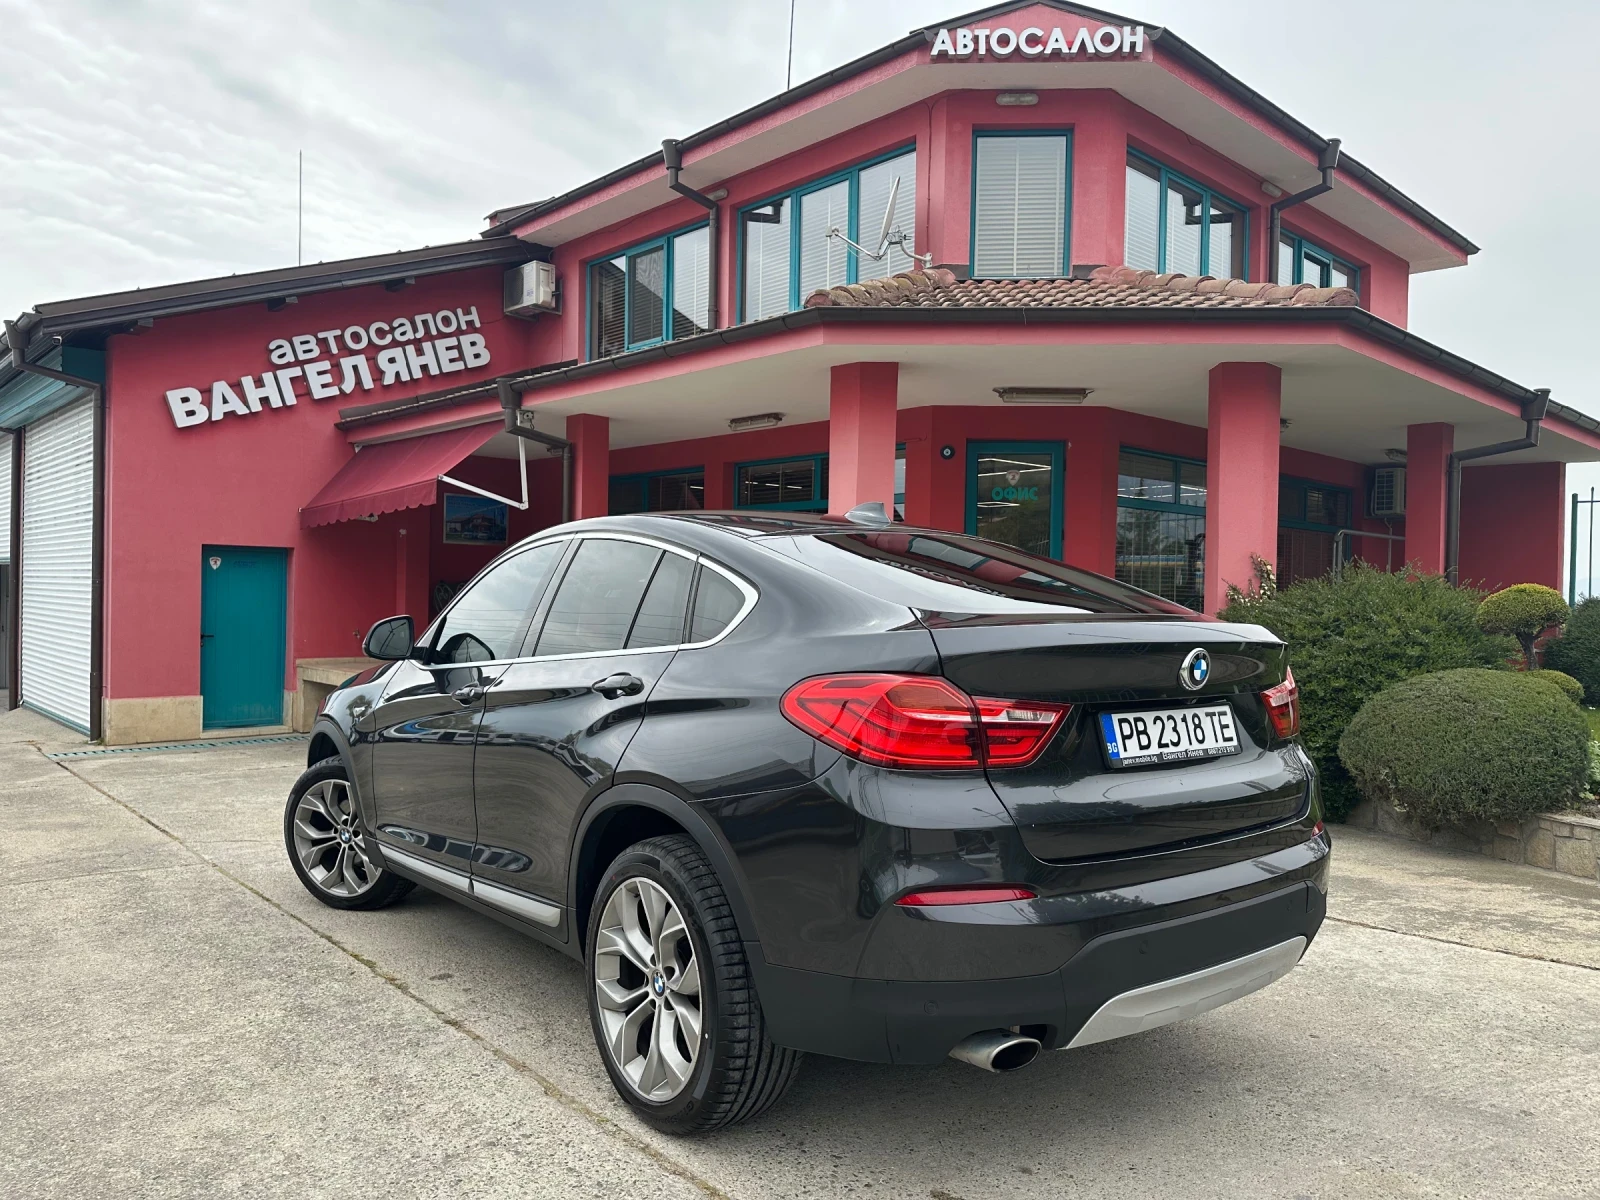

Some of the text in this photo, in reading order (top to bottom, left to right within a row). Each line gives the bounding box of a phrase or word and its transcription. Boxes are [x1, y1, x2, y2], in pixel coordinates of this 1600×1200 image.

[930, 26, 1144, 58] АВТОСАЛОН
[268, 305, 480, 365] автосалон
[165, 333, 491, 428] ВАНГЕЛ ЯНЕВ
[991, 487, 1039, 501] ОФИС
[1107, 743, 1118, 753] BG
[1118, 710, 1234, 752] PB 2318 TE
